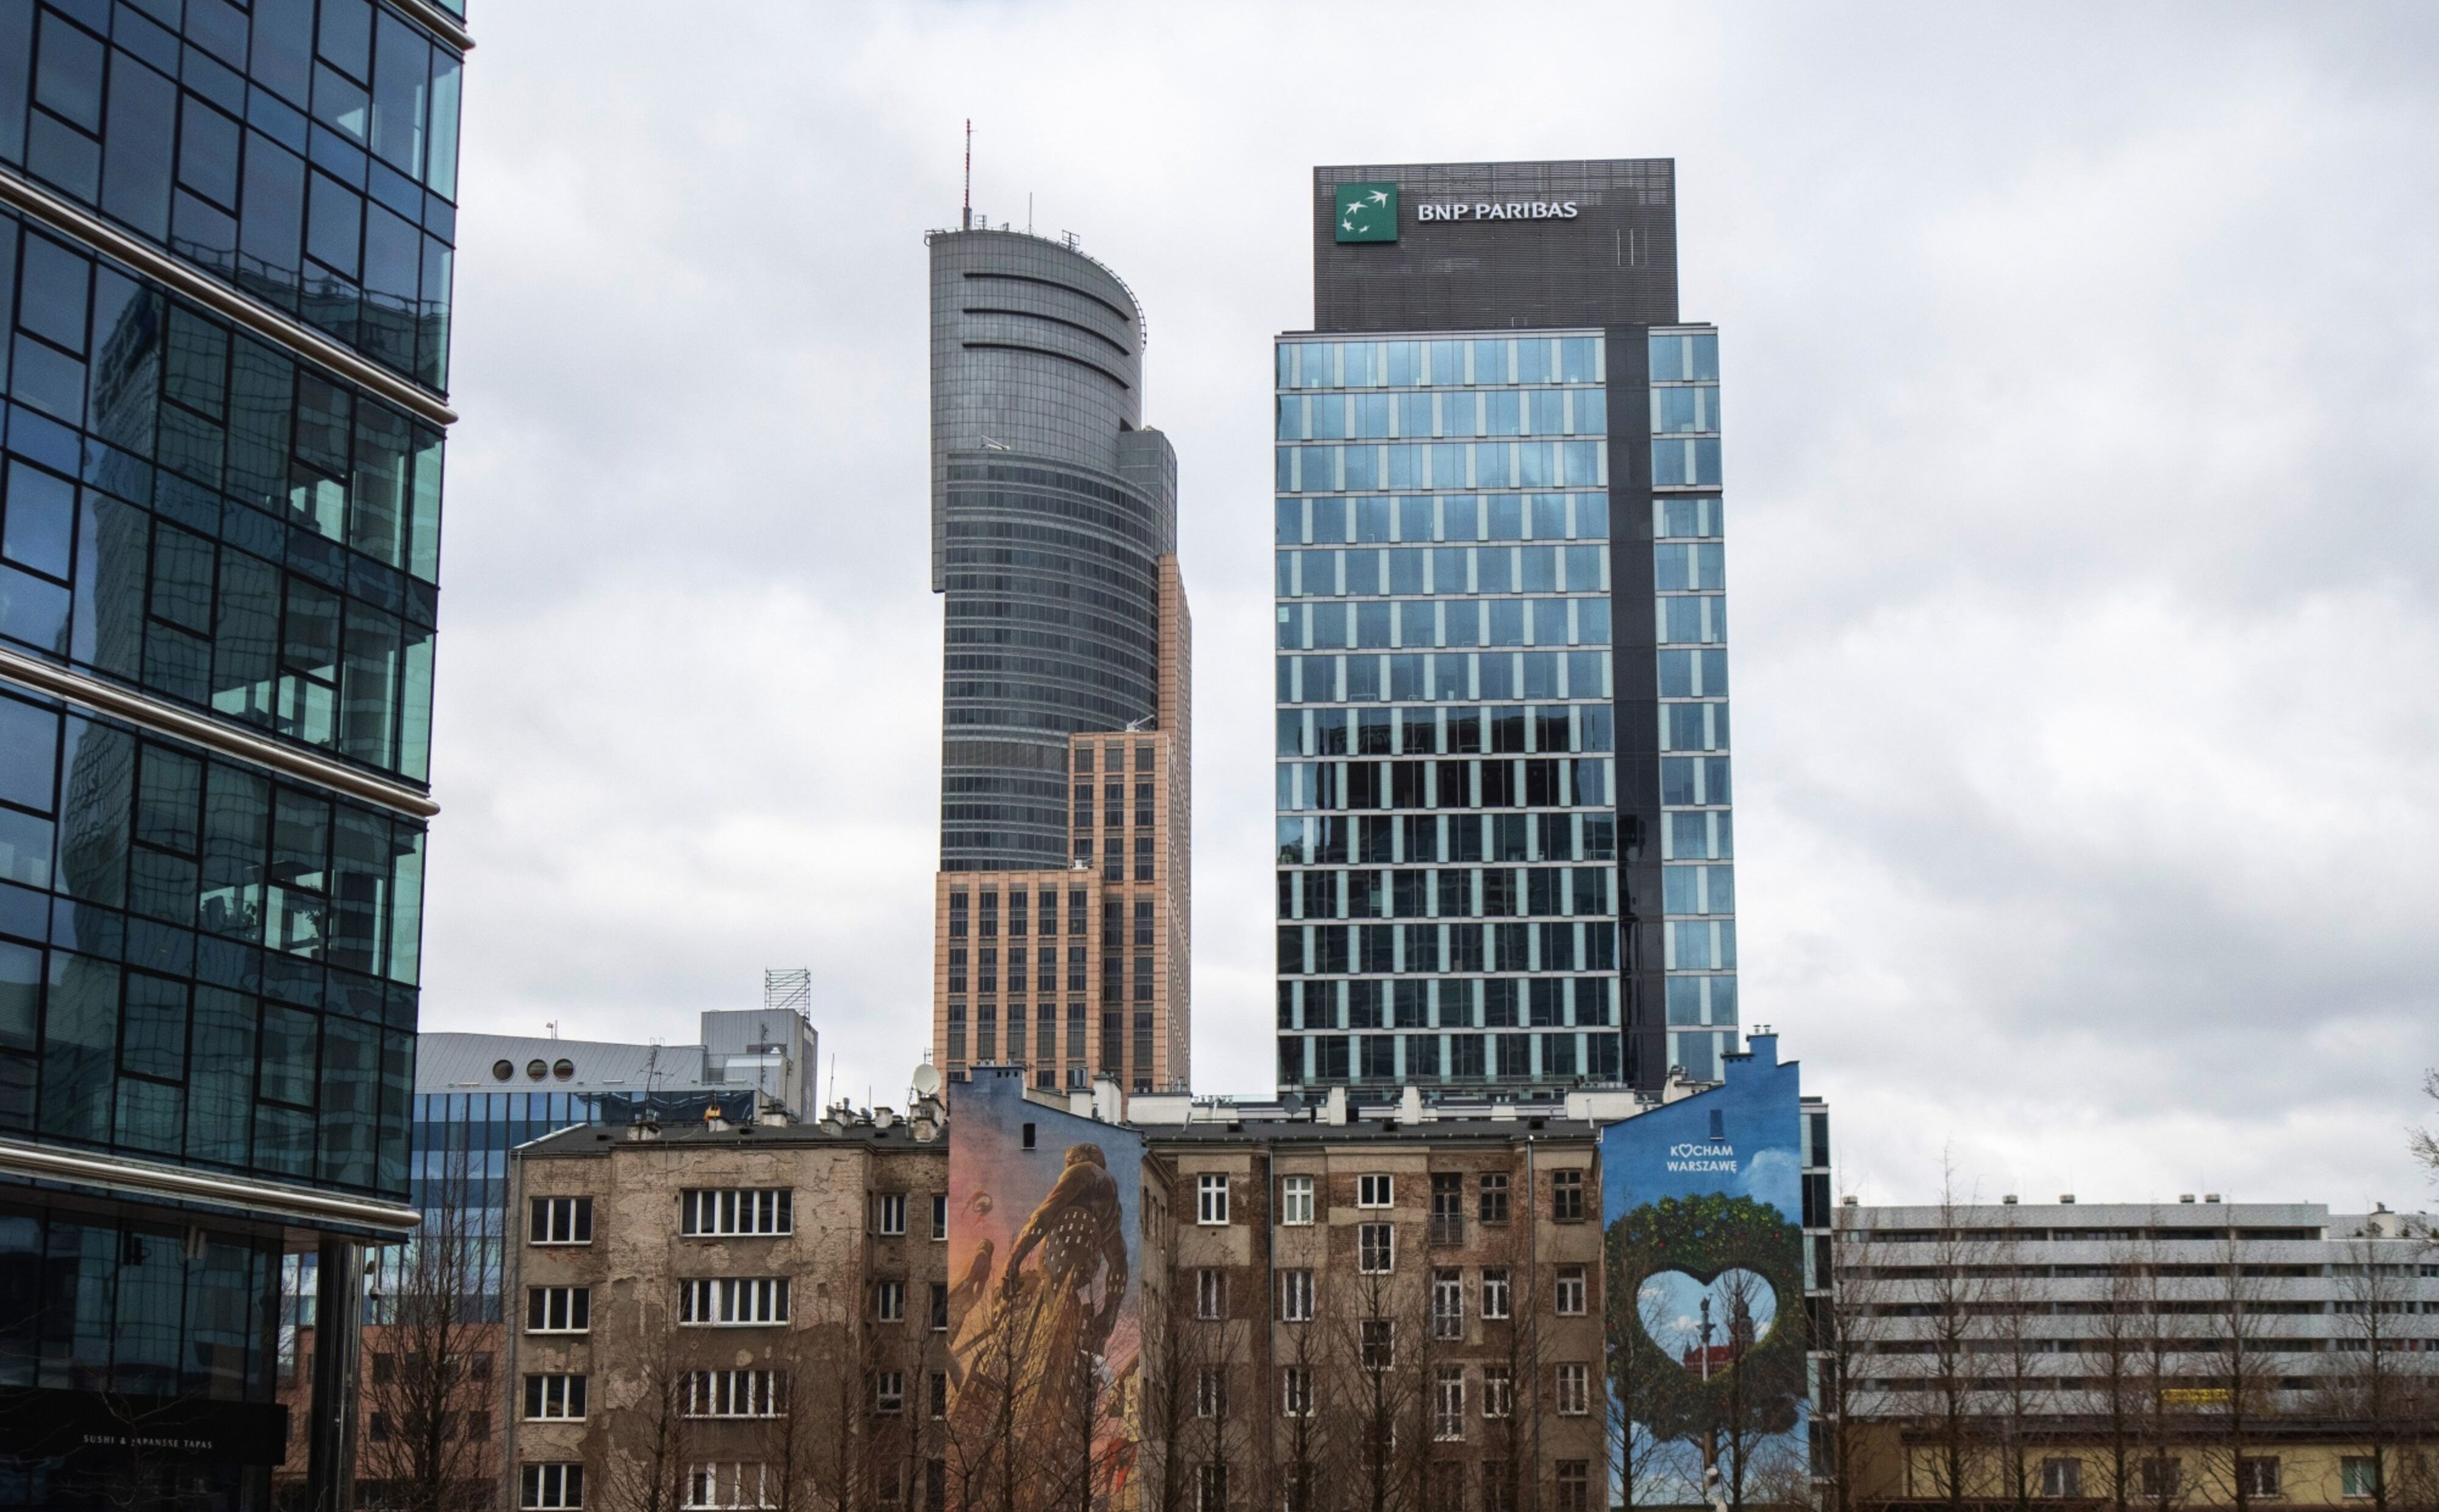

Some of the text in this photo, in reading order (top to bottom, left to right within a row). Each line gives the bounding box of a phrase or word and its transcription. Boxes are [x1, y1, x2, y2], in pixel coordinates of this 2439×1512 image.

[1418, 201, 1578, 220] BNP PARIBAS
[1667, 1160, 1737, 1173] WARSZAWĘ
[83, 1435, 115, 1444] SUSHI
[184, 1440, 212, 1449] TAPAS
